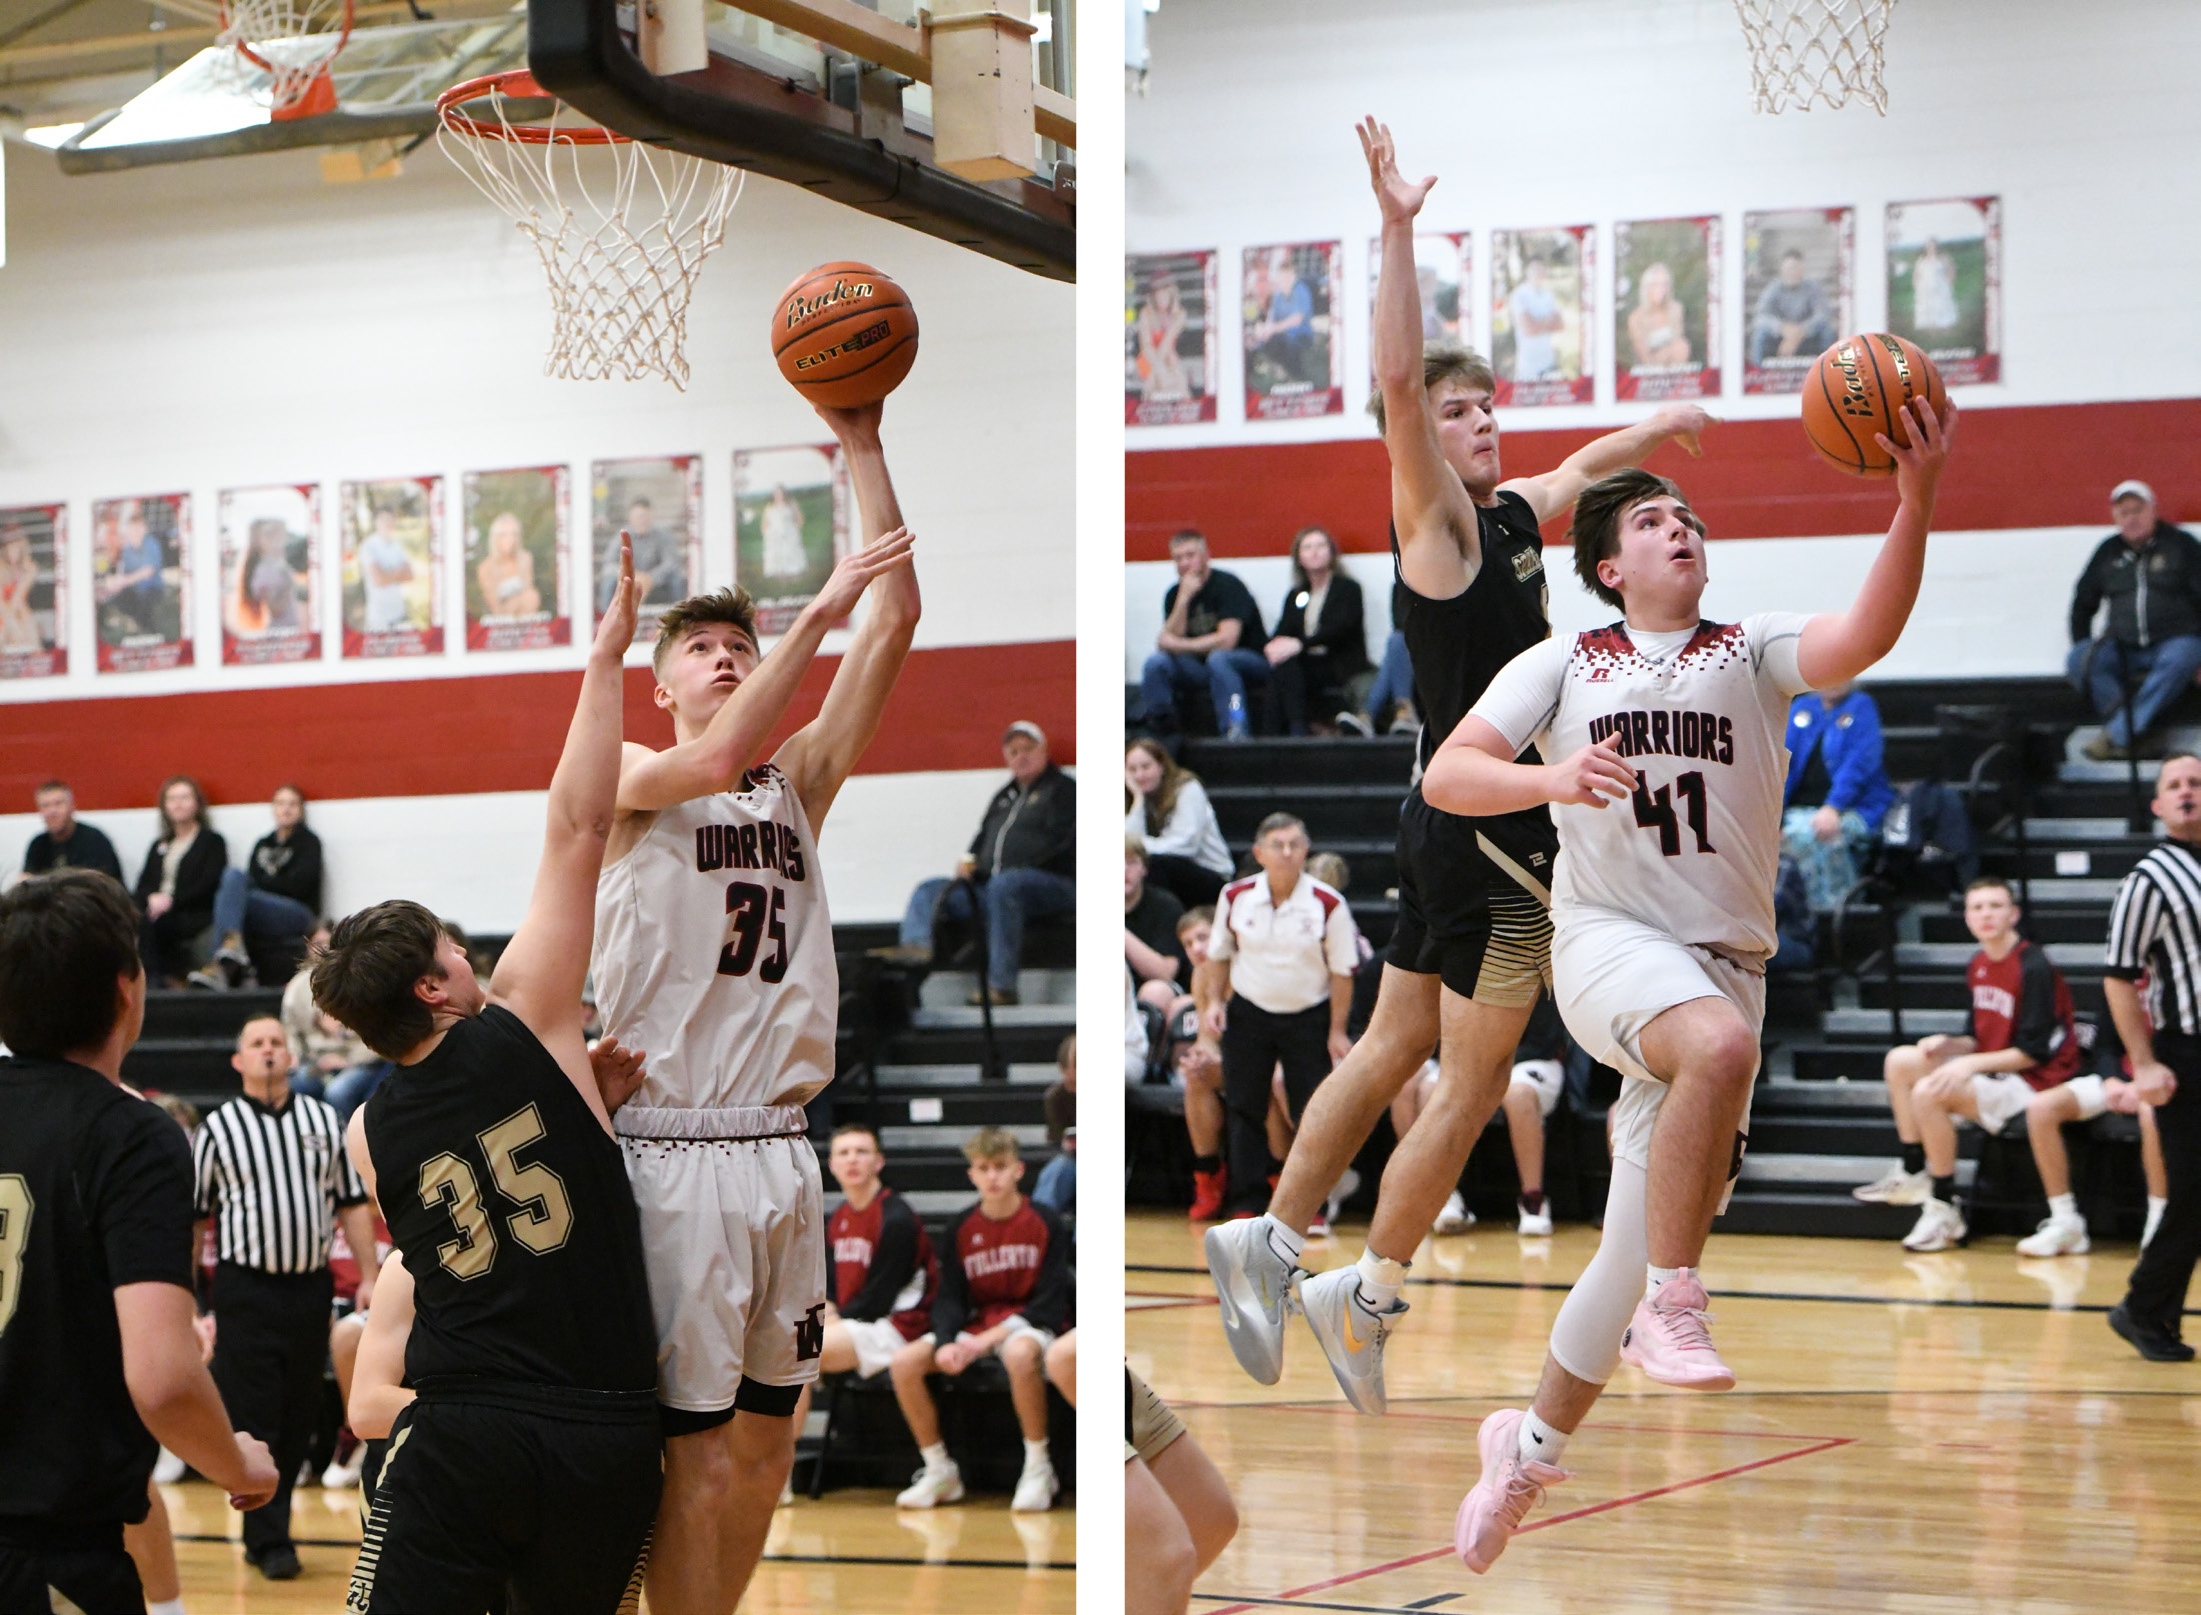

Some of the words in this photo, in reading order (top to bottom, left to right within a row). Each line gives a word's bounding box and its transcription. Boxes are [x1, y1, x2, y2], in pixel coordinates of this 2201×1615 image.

[787, 280, 873, 332] Baden
[794, 339, 862, 371] ELITE
[861, 320, 890, 347] PRO
[1589, 710, 1733, 766] WARRIORS
[1631, 769, 1717, 857] 41
[696, 821, 806, 882] WARRIS
[717, 881, 788, 984] 35
[418, 1101, 575, 1282] 35
